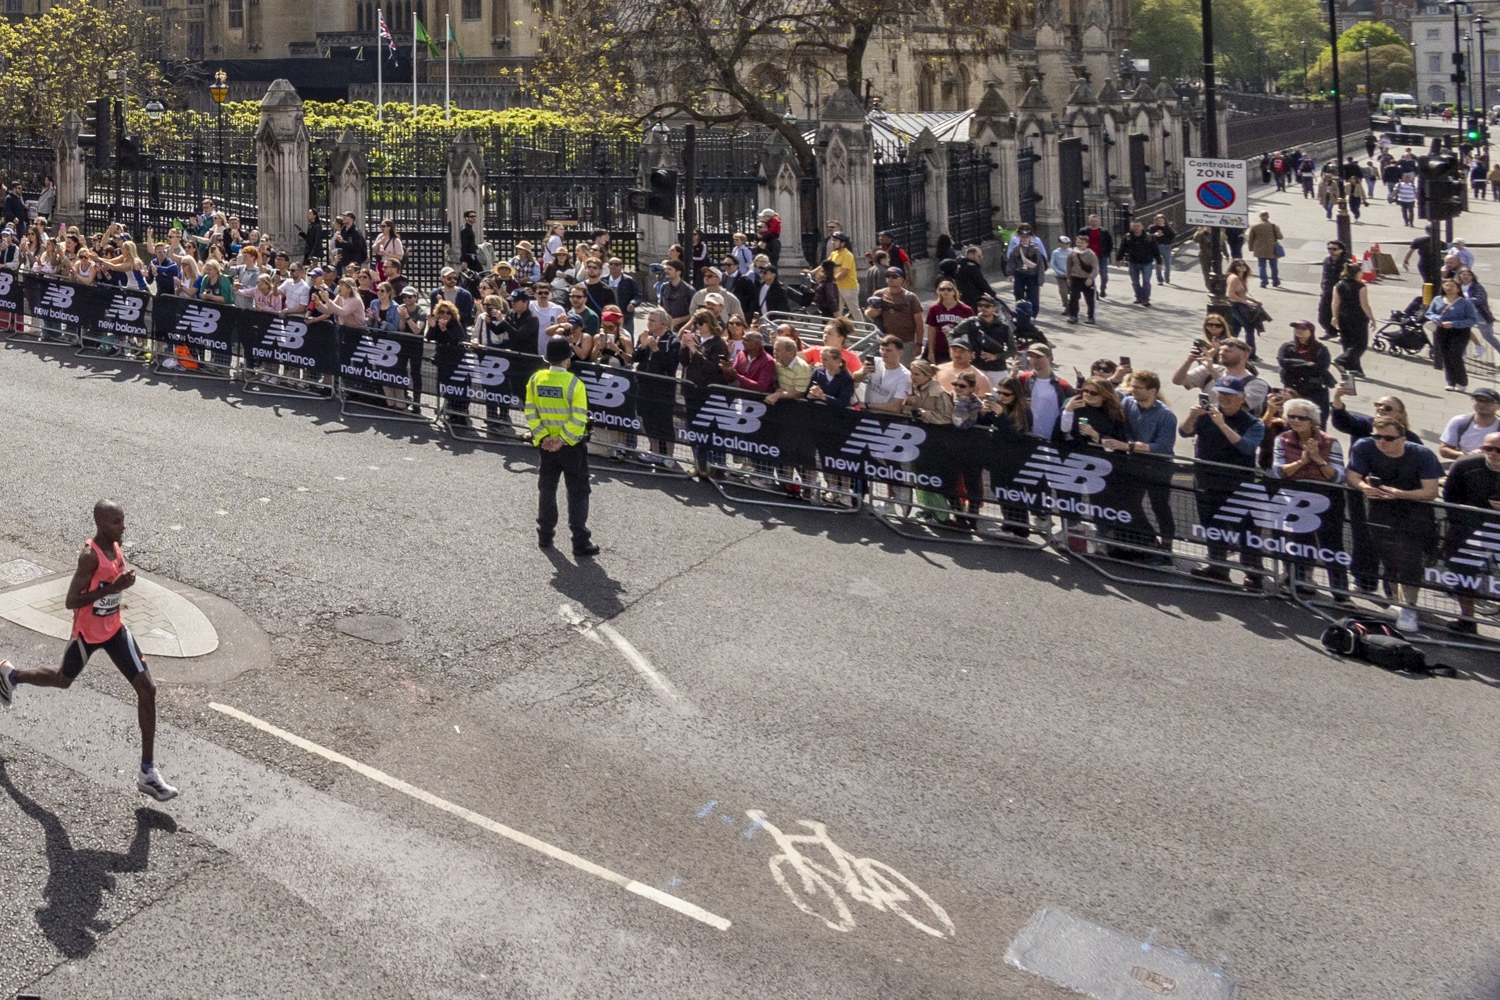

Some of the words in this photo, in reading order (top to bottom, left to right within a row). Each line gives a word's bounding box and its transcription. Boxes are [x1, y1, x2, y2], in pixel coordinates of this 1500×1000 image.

[1189, 160, 1243, 169] Controlled
[1196, 169, 1235, 179] ZONE
[33, 306, 49, 317] new
[49, 308, 80, 324] balance
[97, 319, 115, 330] new
[115, 321, 147, 336] balance
[167, 331, 187, 342] new
[187, 332, 228, 351] balance
[252, 346, 273, 359] new
[274, 349, 316, 367] balance
[340, 363, 363, 376] new
[364, 367, 411, 387] balance
[439, 382, 465, 396] new
[466, 385, 520, 406] balance
[538, 389, 563, 398] POLICE
[678, 428, 710, 444] new
[712, 432, 780, 458] balance
[824, 455, 861, 473] new
[864, 459, 943, 488] balance
[995, 486, 1037, 505] new
[1041, 492, 1133, 523] balance
[1191, 523, 1240, 545] new
[1246, 529, 1352, 566] balance
[1424, 567, 1482, 590] new
